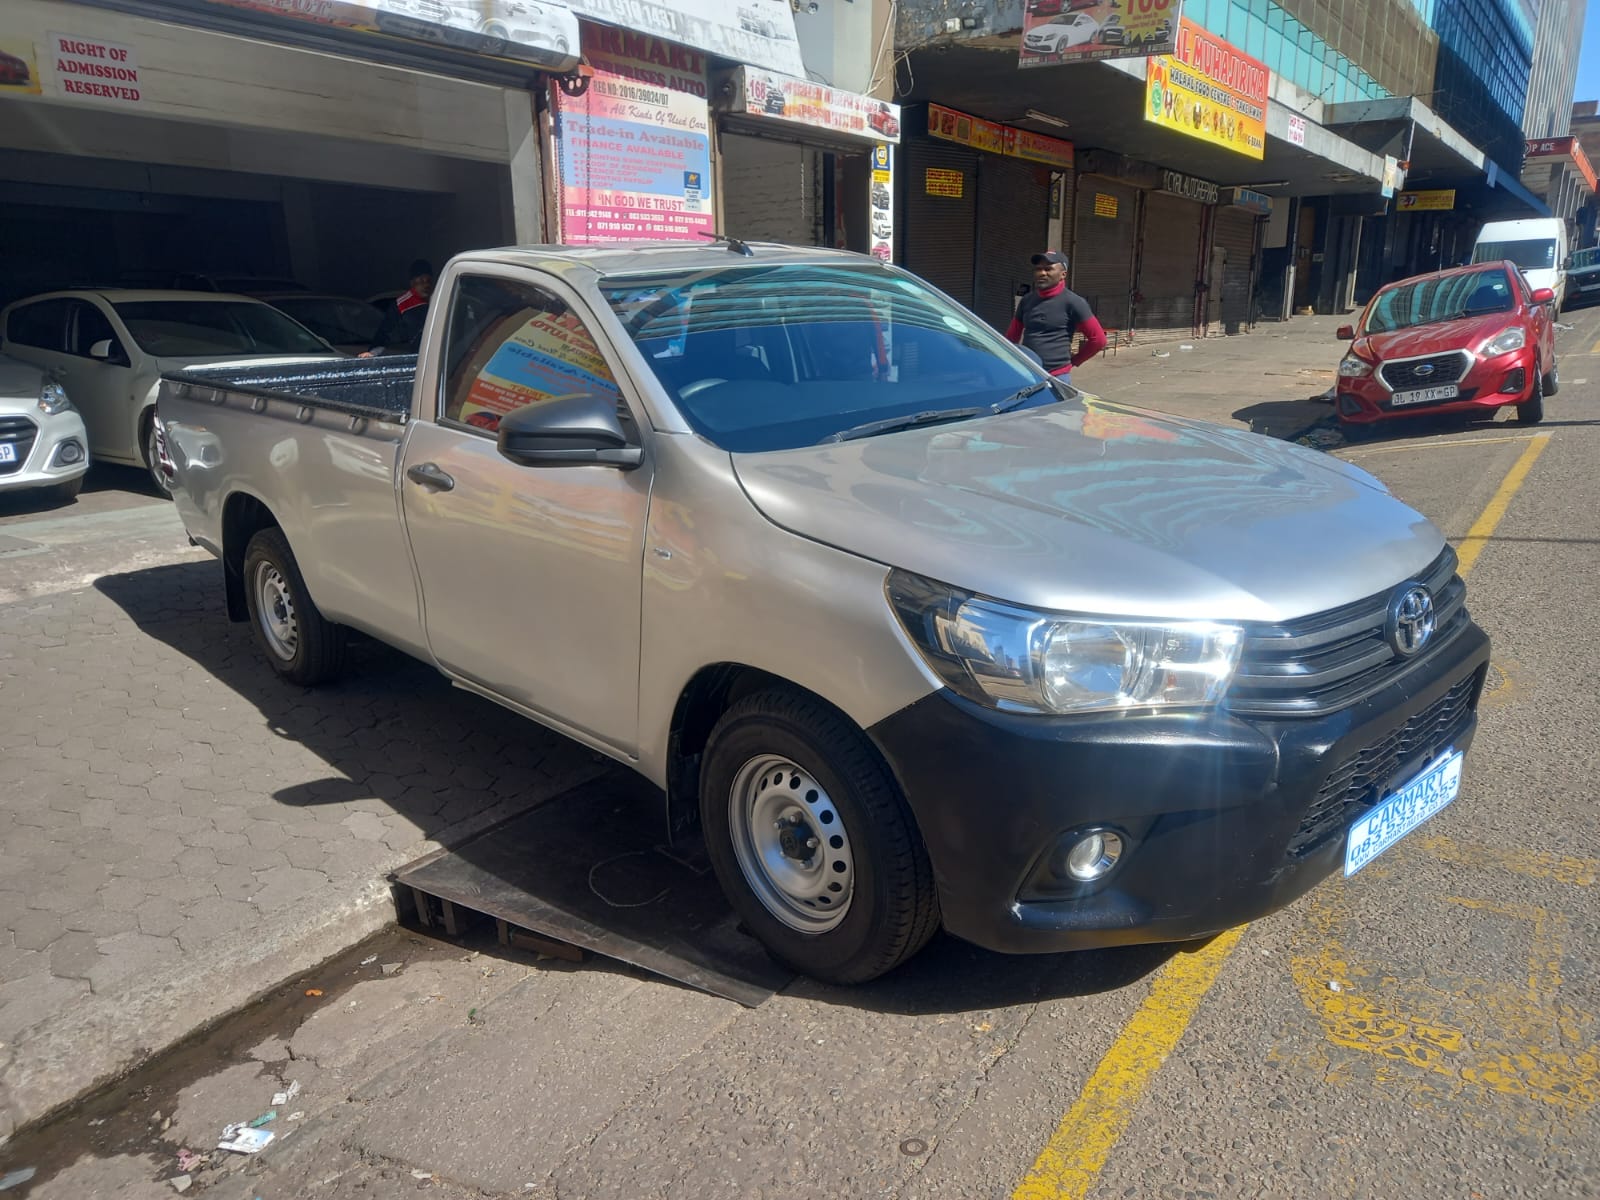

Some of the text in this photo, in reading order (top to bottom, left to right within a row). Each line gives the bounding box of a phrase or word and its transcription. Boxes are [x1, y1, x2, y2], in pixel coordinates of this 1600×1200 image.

[59, 39, 127, 62] RIGHT OF
[56, 59, 138, 82] ADMISSION
[64, 79, 140, 101] RESERVED
[669, 73, 706, 97] AUTO
[750, 79, 766, 99] 168
[626, 143, 684, 160] AVAILABLE
[640, 130, 704, 151] Available
[615, 195, 635, 208] GOD
[637, 197, 651, 209] WE
[1368, 767, 1448, 835] CARMART
[1351, 774, 1458, 862] 083 533 3653
